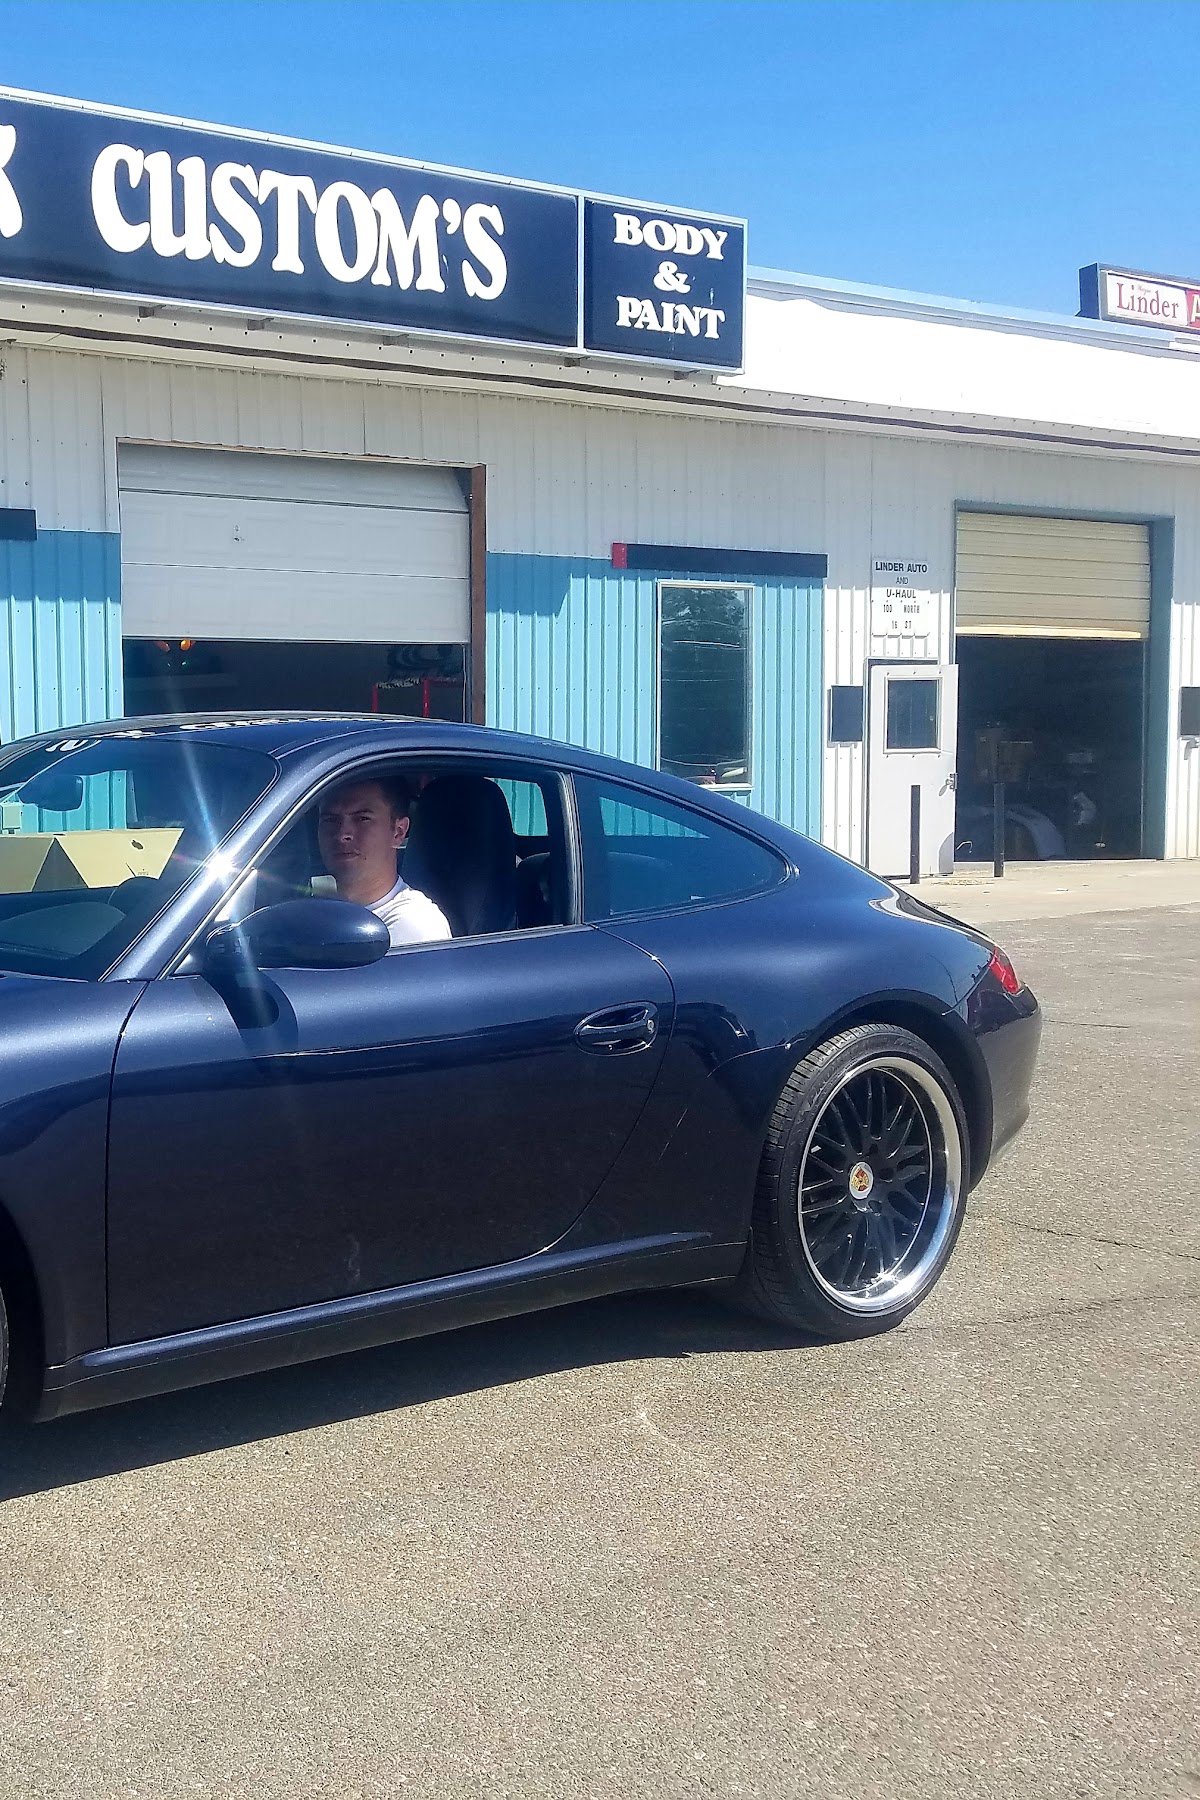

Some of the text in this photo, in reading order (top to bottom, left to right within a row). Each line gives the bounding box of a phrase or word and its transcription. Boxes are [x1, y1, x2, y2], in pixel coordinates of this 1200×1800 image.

[91, 143, 508, 300] CUSTOM'S
[613, 212, 728, 261] BODY
[653, 260, 691, 294] &
[616, 296, 726, 339] PAINT
[1116, 282, 1179, 319] Linder
[875, 561, 928, 573] LINDER AUTO
[886, 588, 917, 599] U-HAUL
